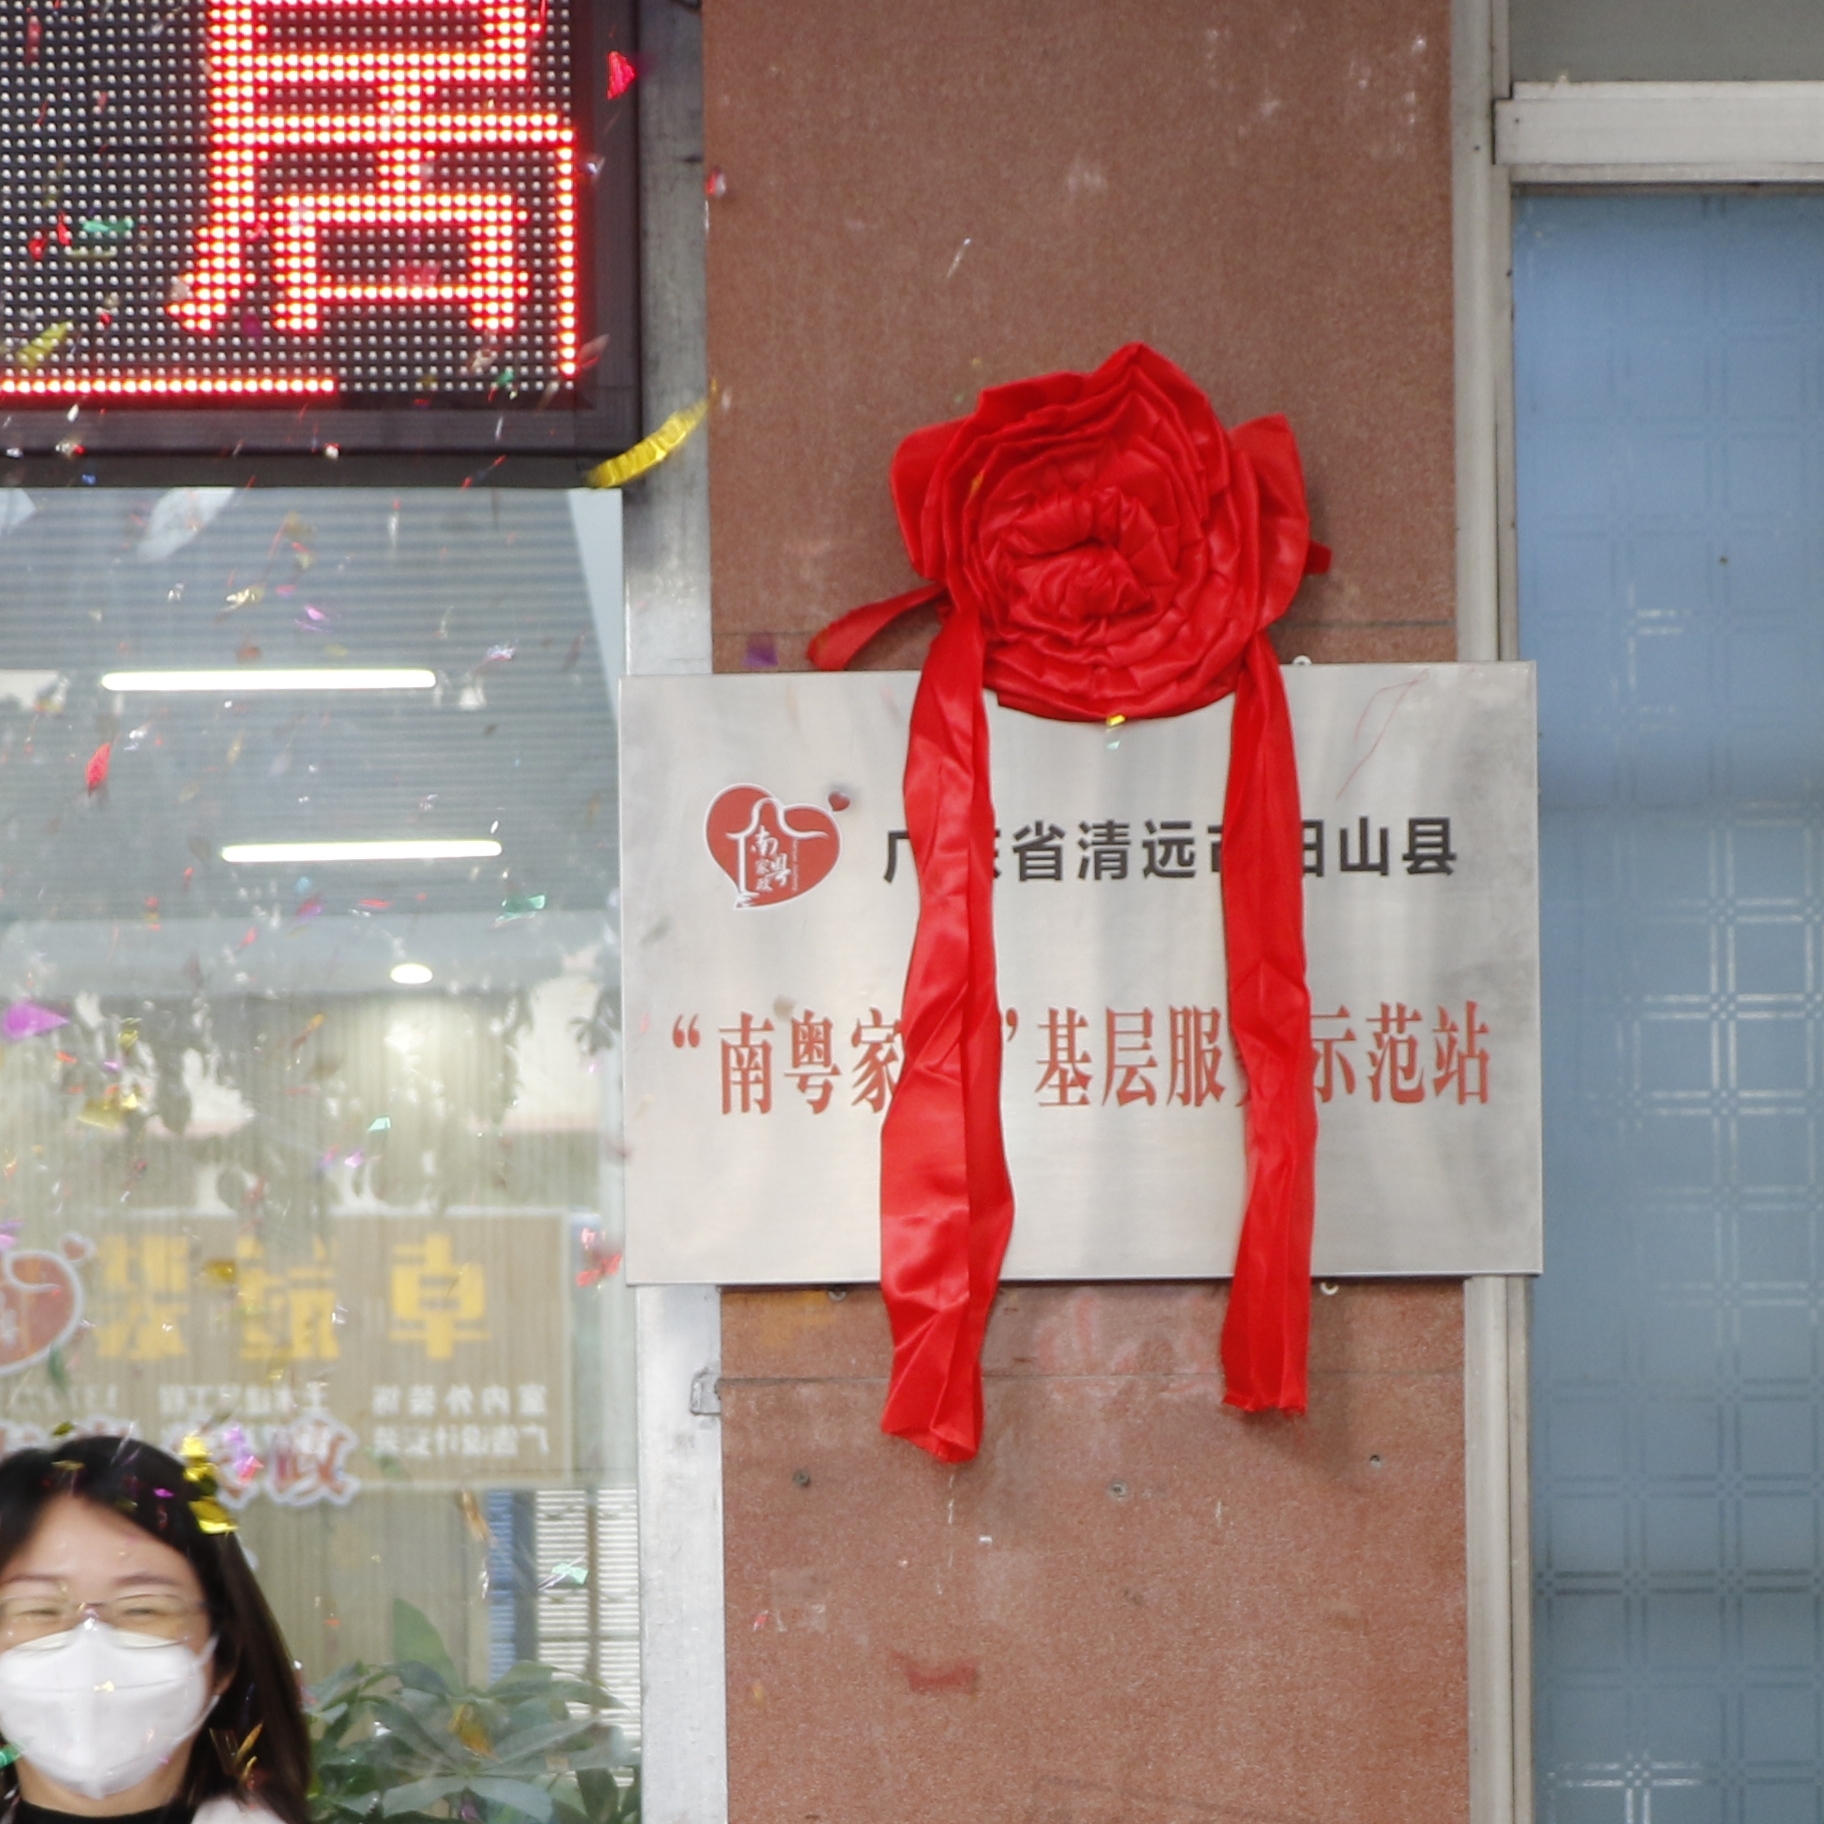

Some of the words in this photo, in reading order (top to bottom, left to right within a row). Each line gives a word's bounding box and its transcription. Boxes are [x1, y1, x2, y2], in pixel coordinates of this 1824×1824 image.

[672, 1000, 1490, 1116] “南粤家”基层服示范站
